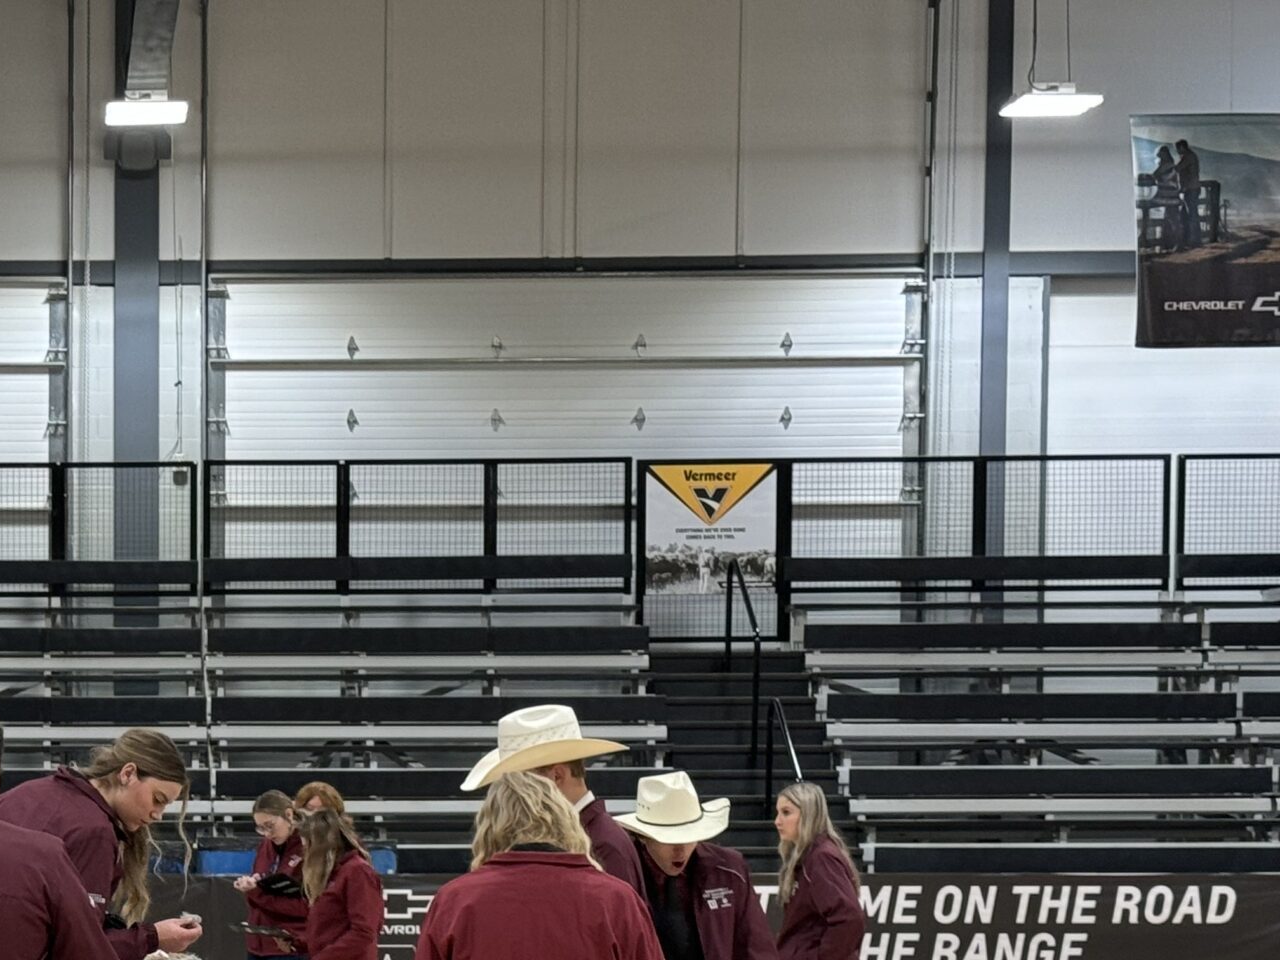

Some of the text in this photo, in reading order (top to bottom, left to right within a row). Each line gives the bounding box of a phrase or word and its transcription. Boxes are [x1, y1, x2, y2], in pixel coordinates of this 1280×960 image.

[1164, 300, 1245, 311] CHEVROLET
[683, 470, 737, 482] Vermeer
[753, 885, 1237, 924] T ME ON THE ROAD
